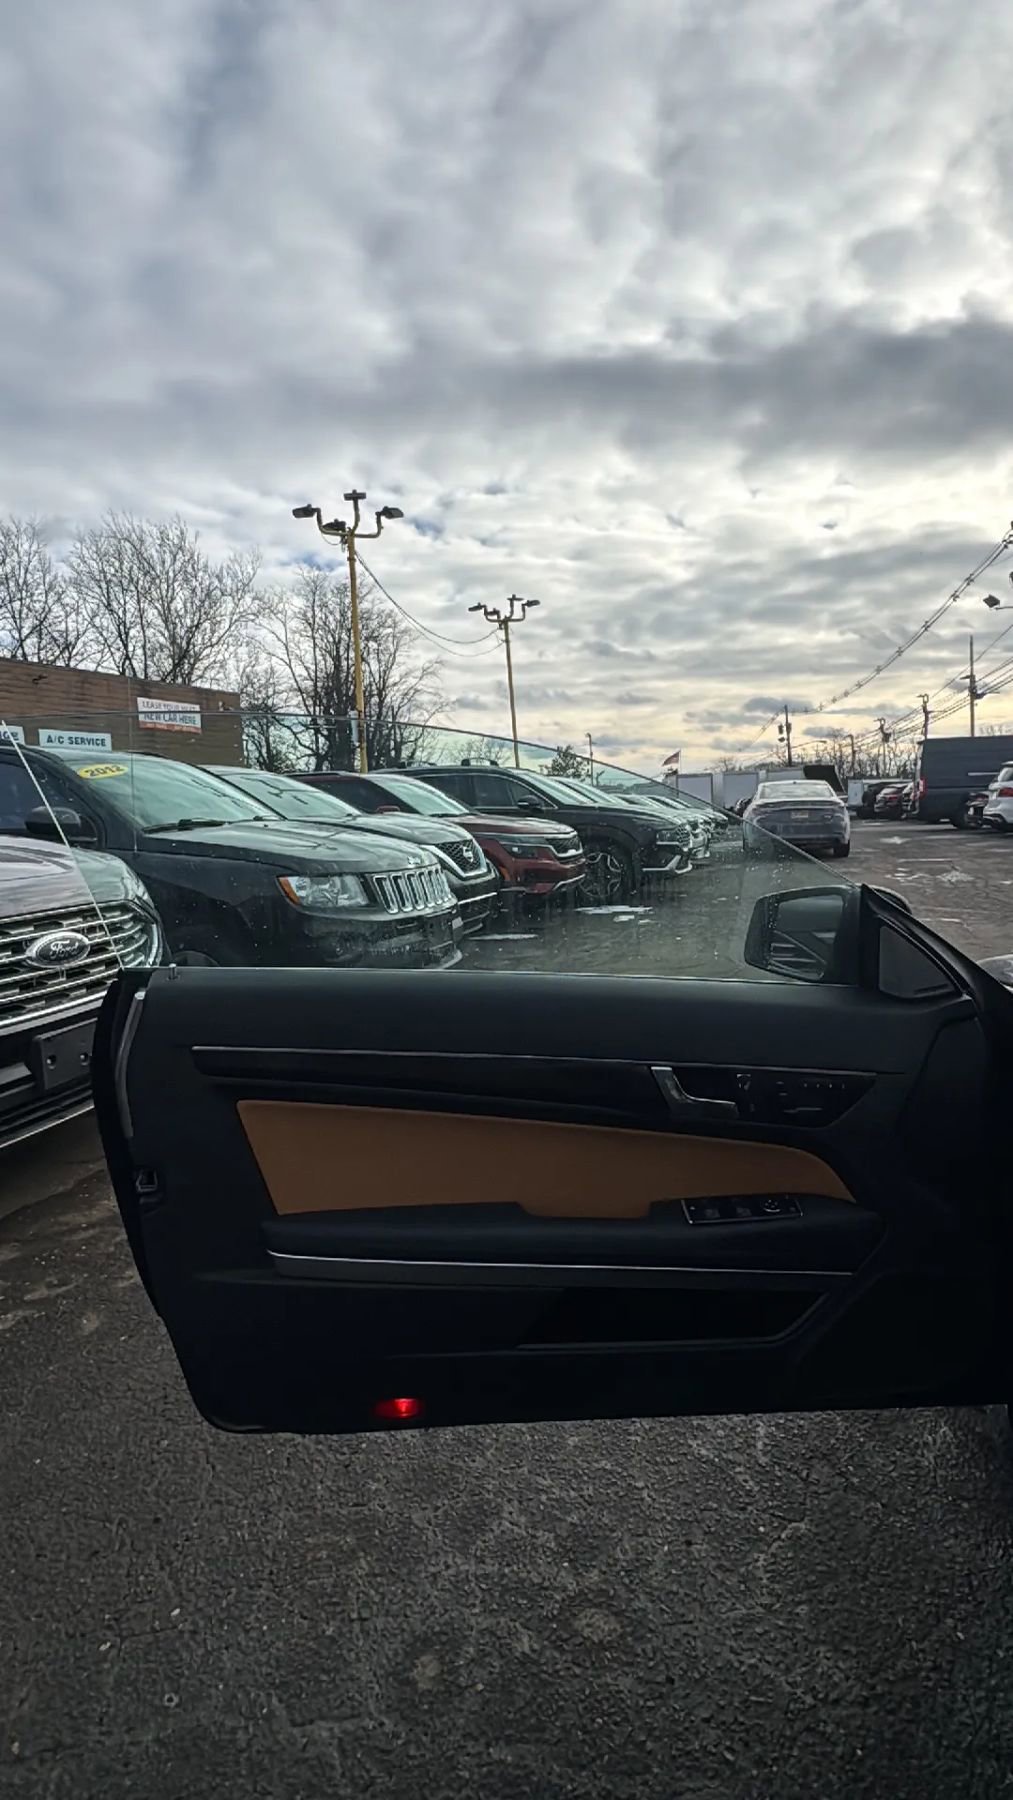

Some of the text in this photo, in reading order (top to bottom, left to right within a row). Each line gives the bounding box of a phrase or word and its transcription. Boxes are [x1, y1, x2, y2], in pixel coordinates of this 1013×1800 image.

[144, 712, 197, 725] NEW CAR HERE
[46, 734, 106, 747] A/C SERVICE
[84, 764, 125, 777] 2012
[49, 940, 79, 959] Ford
